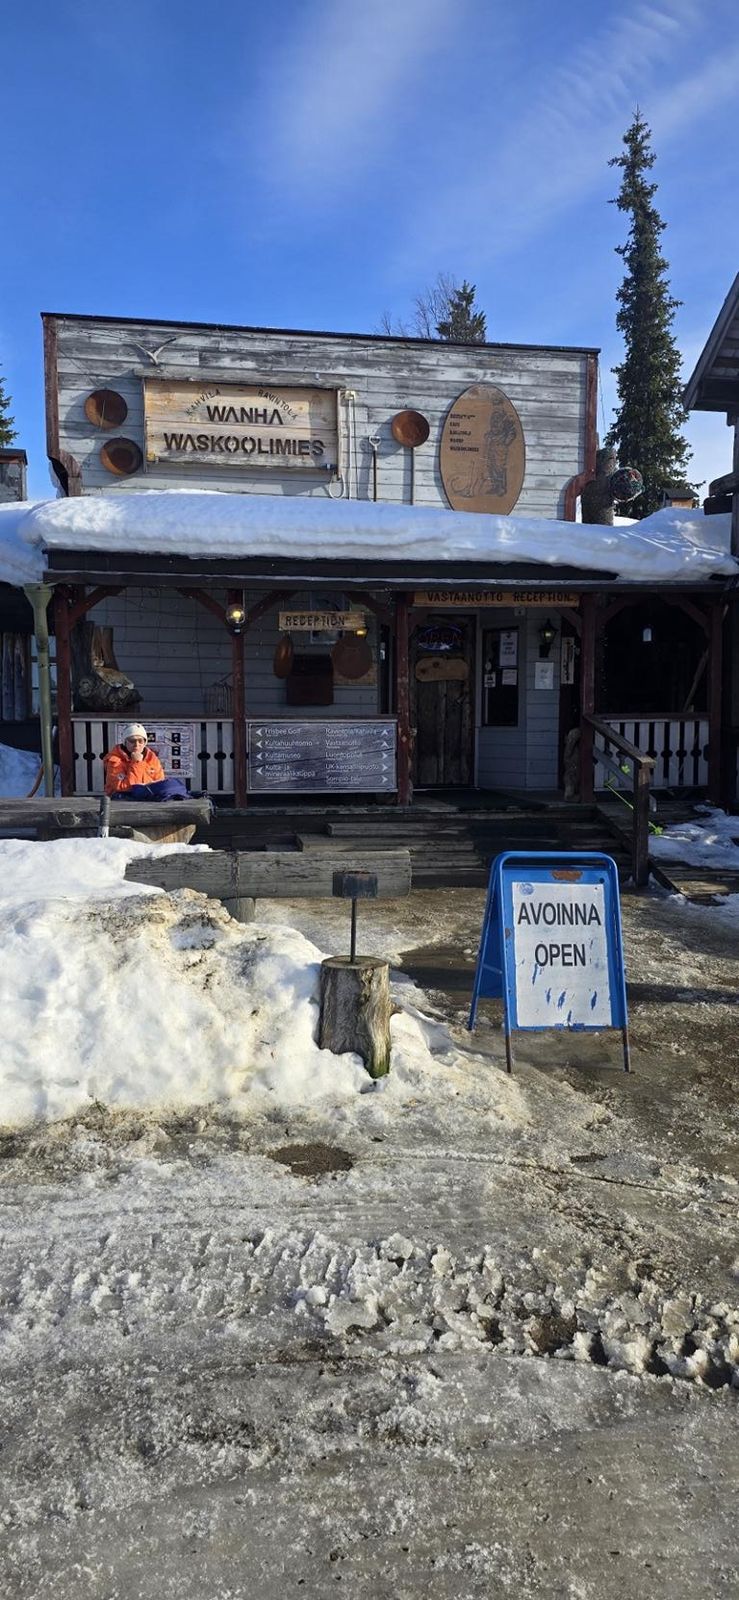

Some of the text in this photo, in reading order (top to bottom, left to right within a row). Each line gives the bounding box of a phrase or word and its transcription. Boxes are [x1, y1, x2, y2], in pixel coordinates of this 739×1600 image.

[186, 388, 221, 416] KAHVILA
[257, 388, 298, 420] RAVINTOLA
[206, 405, 284, 425] WANHA
[163, 433, 326, 457] WASKOOLIMIES
[427, 591, 503, 602] VASTAANOTTO
[285, 615, 345, 627] RECEPTION
[517, 902, 601, 926] AVOINNA
[534, 943, 586, 967] OPEN
